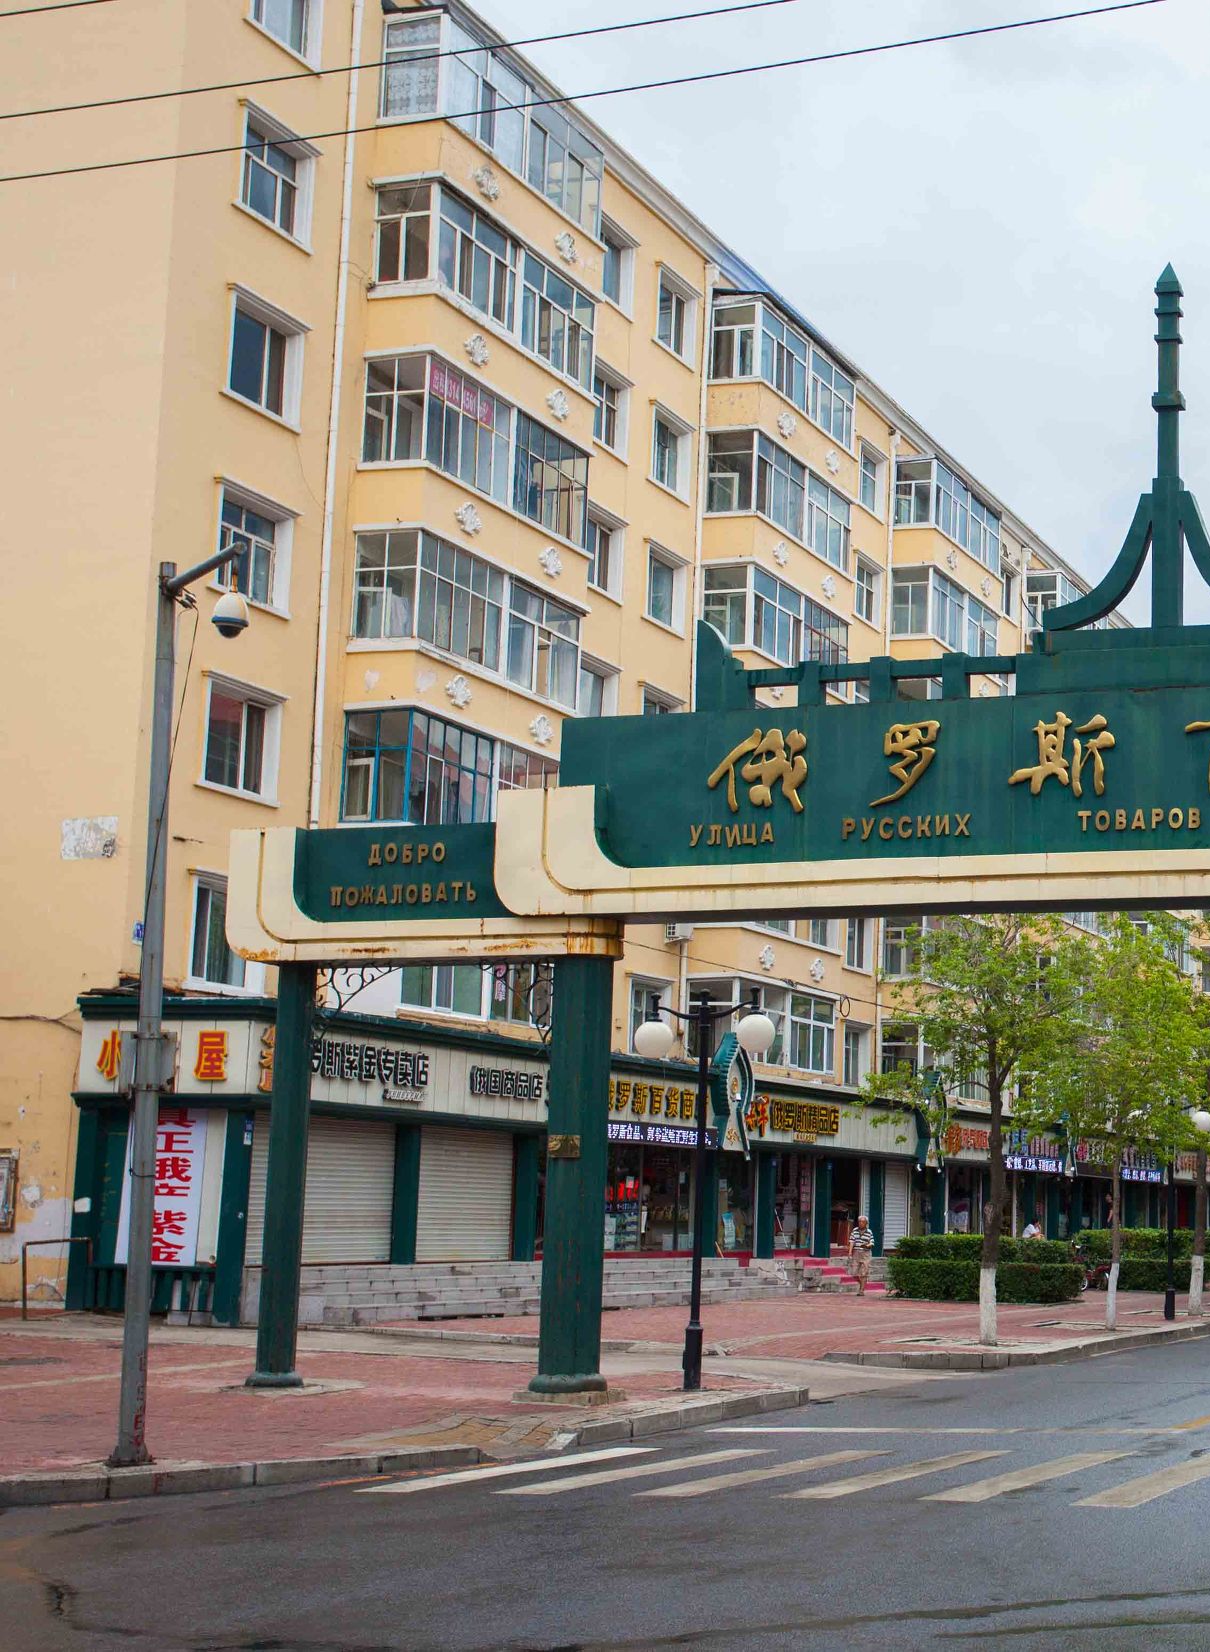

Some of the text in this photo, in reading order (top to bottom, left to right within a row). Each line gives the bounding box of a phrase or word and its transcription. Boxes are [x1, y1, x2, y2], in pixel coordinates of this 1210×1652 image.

[689, 822, 774, 848] УЛИЦА
[841, 812, 971, 841] РУССКИХ
[1078, 807, 1201, 832] ТОВАРОВ
[368, 841, 446, 867] ДОБРО
[329, 881, 477, 908] ПОЖАЛОВАТЬ
[608, 1079, 708, 1120] 罗斯百货商
